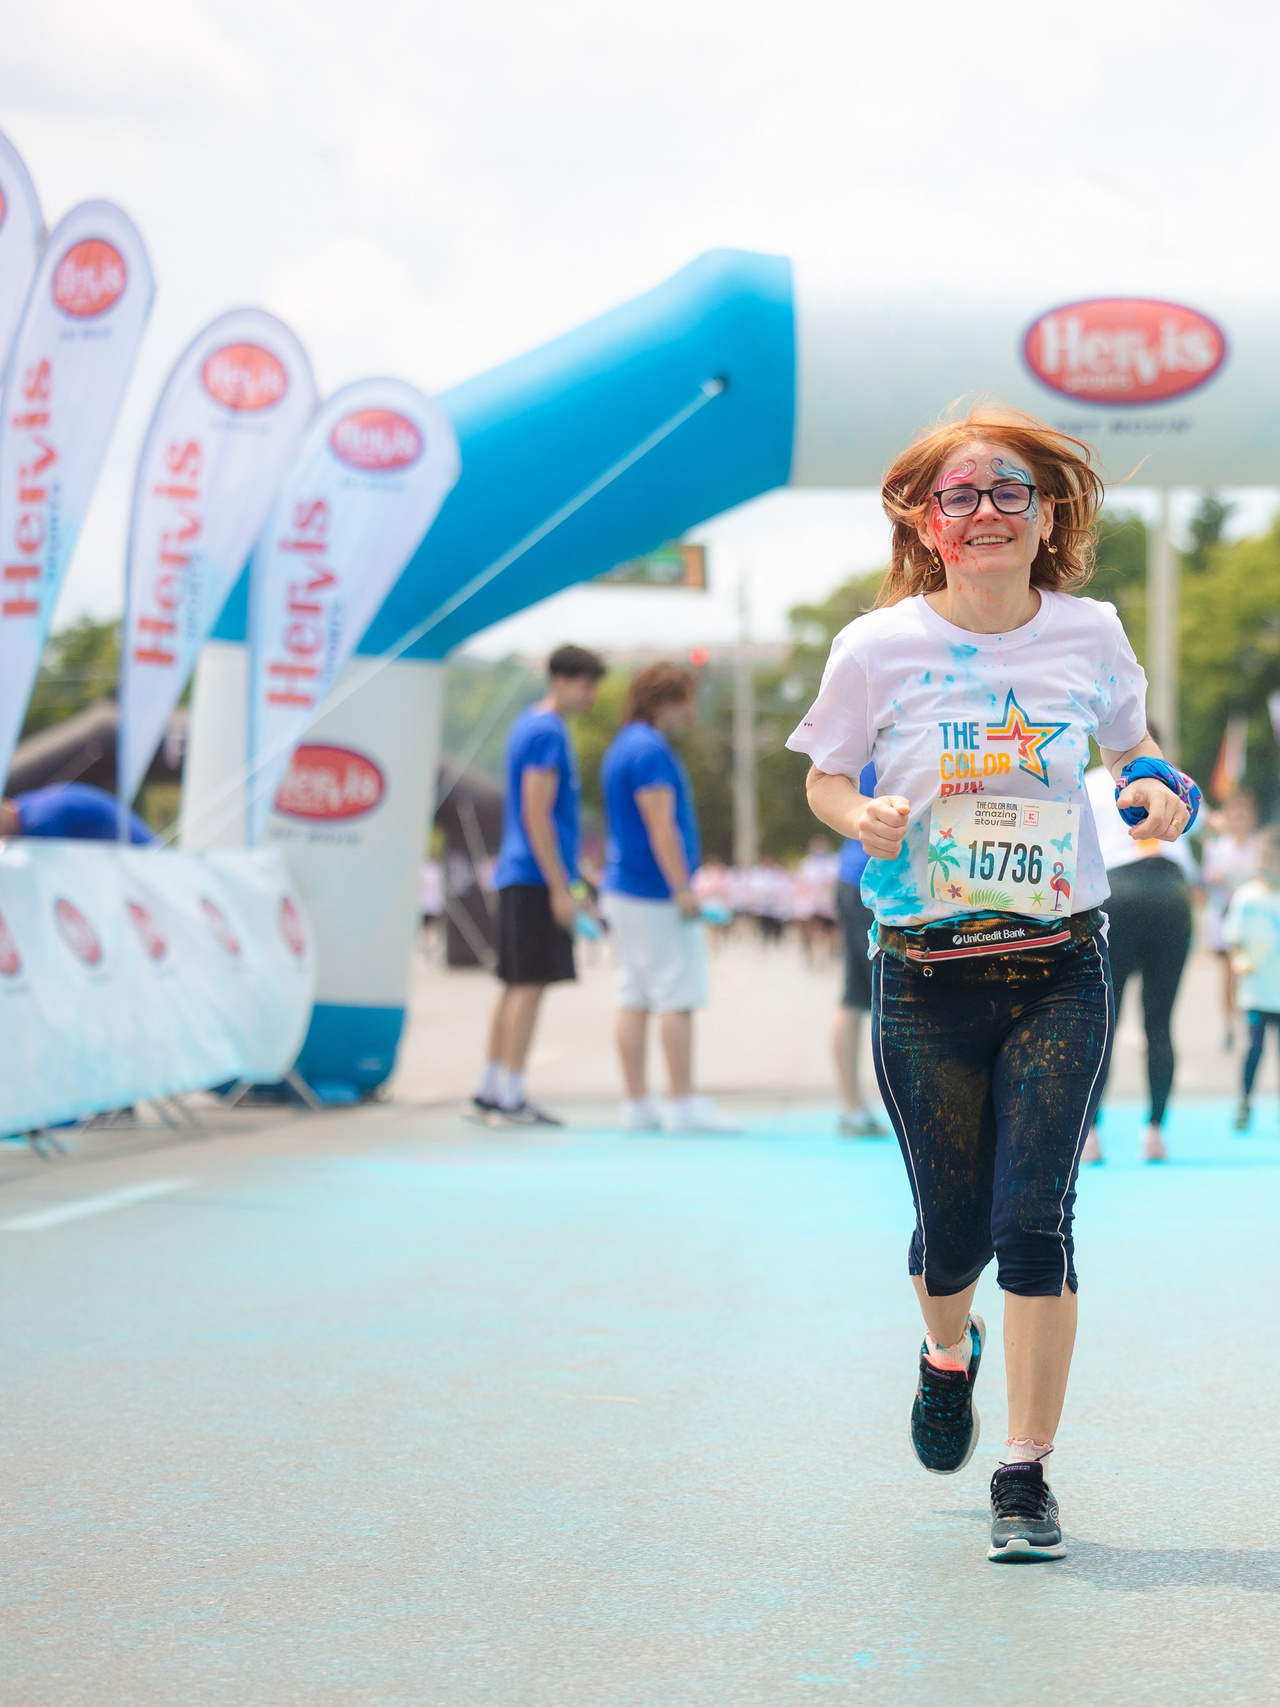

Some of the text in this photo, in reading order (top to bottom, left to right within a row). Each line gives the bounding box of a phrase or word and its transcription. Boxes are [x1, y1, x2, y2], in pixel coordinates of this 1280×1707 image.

[1040, 315, 1216, 386] Hervis
[2, 357, 57, 618] Hervis
[134, 439, 203, 668] Hervis
[267, 498, 338, 709] Hervis
[938, 722, 980, 750] THE
[940, 752, 1011, 781] COLOR
[974, 810, 1017, 821] amazing
[976, 801, 987, 809] THE
[987, 802, 1006, 810] COLOR
[980, 818, 1000, 826] tour
[968, 840, 1043, 885] 15736
[962, 927, 1026, 944] UniCredit Bank
